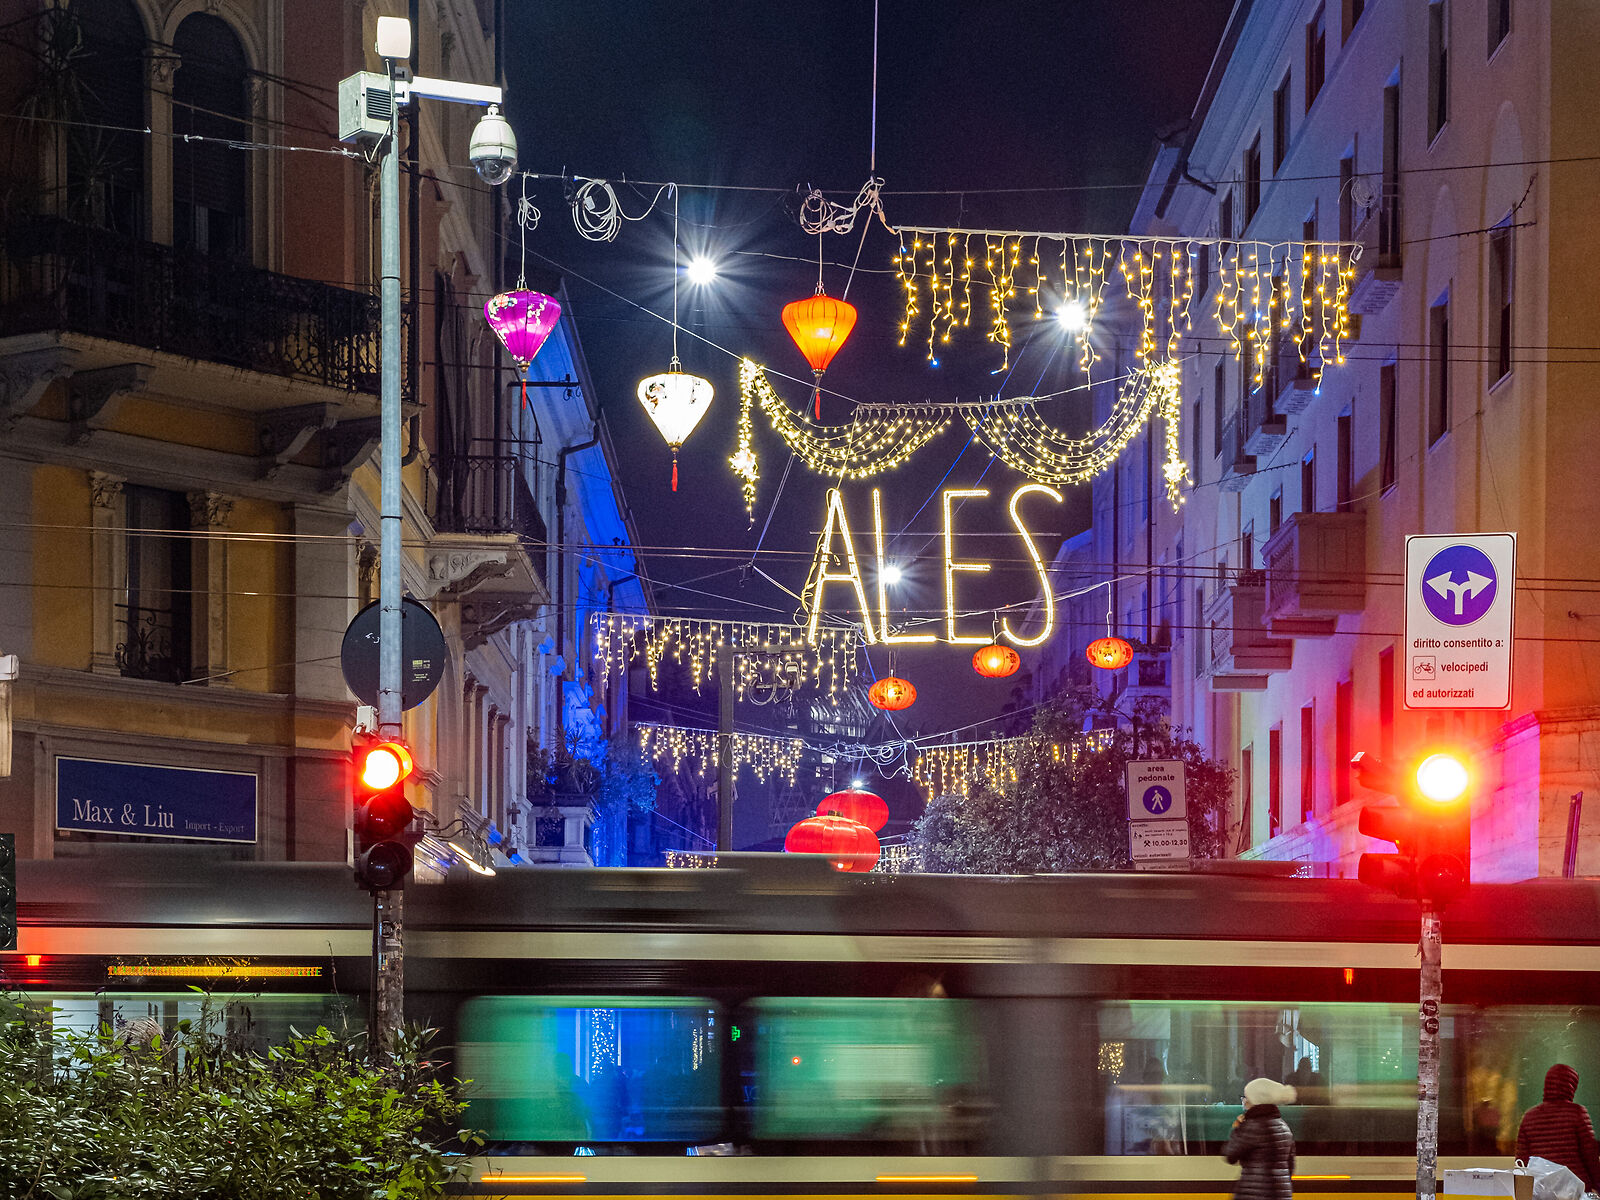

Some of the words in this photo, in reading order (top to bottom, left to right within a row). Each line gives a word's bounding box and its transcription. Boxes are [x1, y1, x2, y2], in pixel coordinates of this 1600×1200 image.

[807, 483, 1063, 647] ALES
[1413, 638, 1441, 649] diritto
[1443, 638, 1493, 648] consentito
[1495, 638, 1504, 648] a:
[1440, 661, 1489, 674] velocipedi
[1412, 688, 1424, 698] ed
[1426, 688, 1475, 698] autorizzati
[1137, 774, 1175, 783] pedonale
[72, 798, 114, 824] Max
[120, 803, 138, 826] &
[143, 804, 175, 829] Liu
[219, 822, 246, 835] Export
